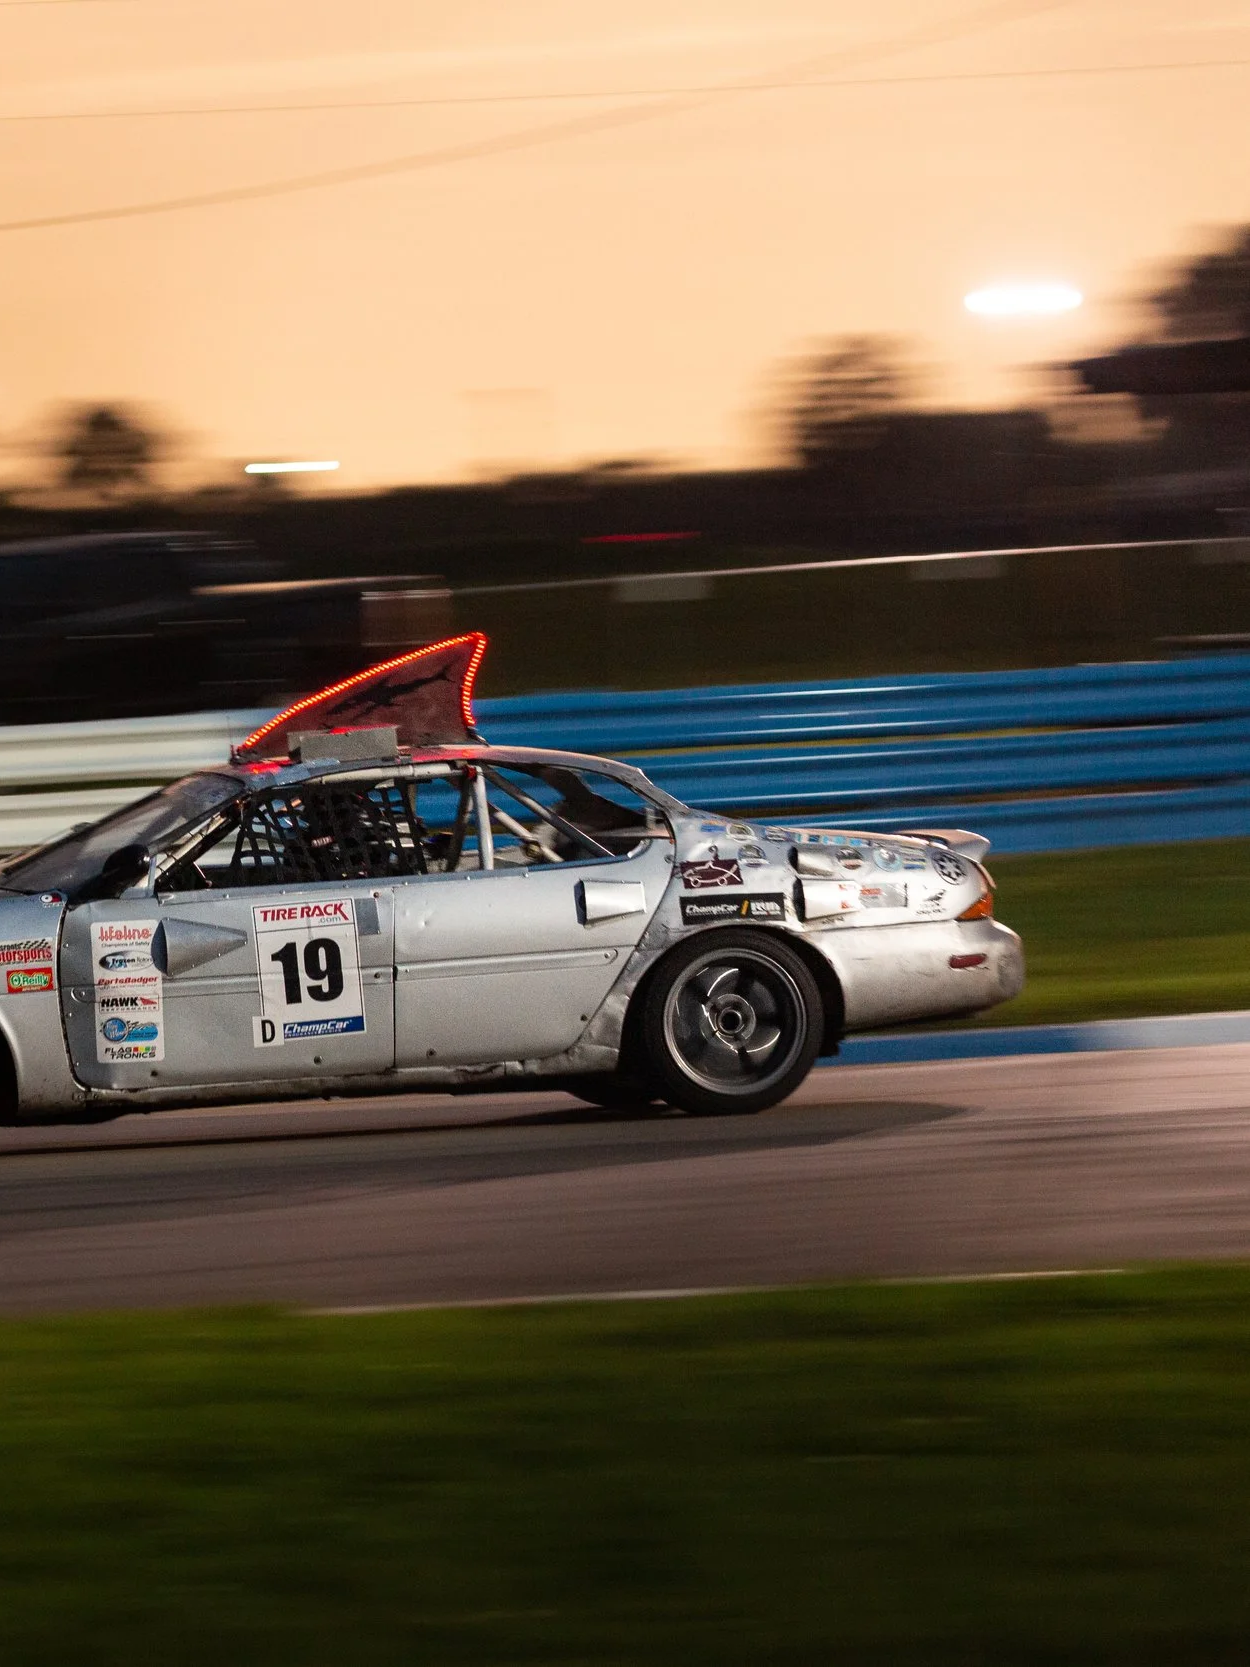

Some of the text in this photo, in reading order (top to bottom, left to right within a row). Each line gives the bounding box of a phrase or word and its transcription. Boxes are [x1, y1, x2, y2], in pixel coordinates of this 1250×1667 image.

[260, 903, 349, 922] TIRE RACK
[271, 938, 344, 1005] 19
[101, 996, 138, 1007] HAWK
[261, 1019, 276, 1043] D
[284, 1020, 349, 1034] ChampCar
